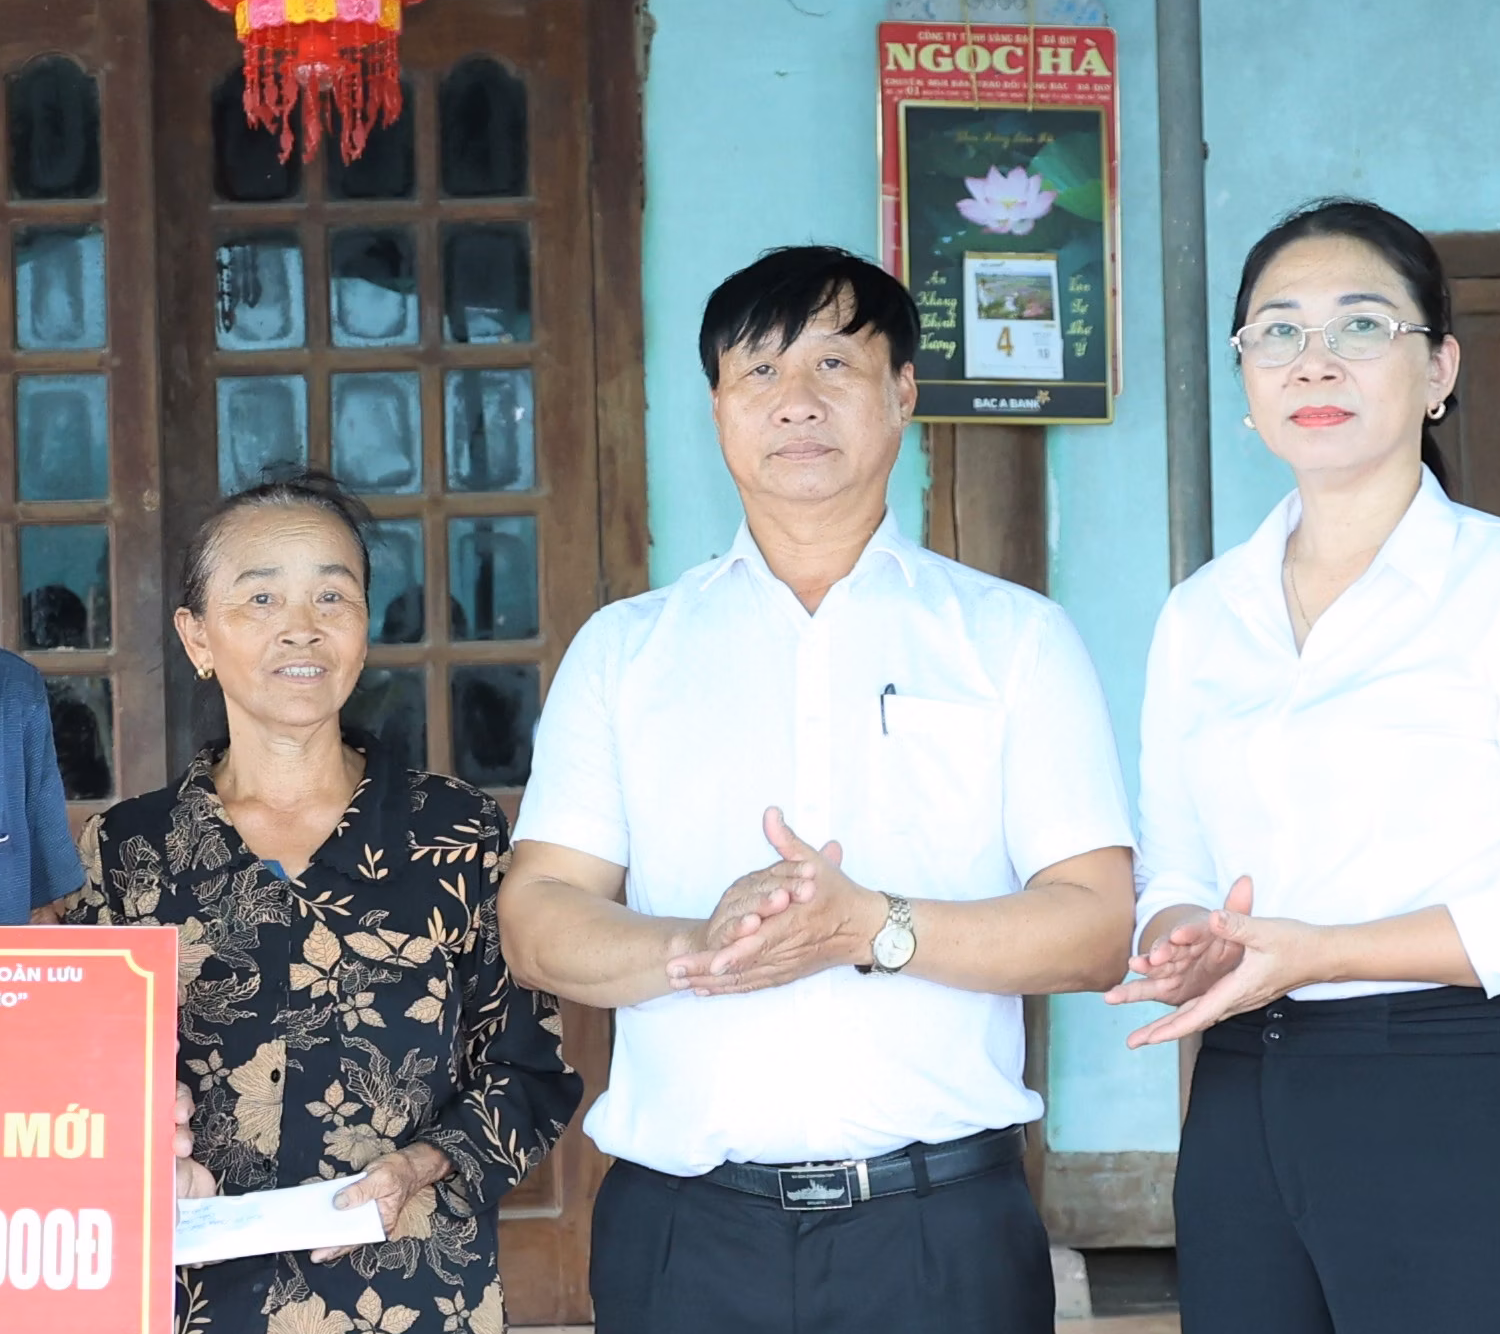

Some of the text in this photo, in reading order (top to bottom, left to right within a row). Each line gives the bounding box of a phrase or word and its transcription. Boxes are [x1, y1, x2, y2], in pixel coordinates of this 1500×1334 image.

[1038, 38, 1113, 77] HÀ
[997, 326, 1014, 358] 4
[47, 966, 83, 982] LƯU
[2, 1102, 106, 1159] MỚI
